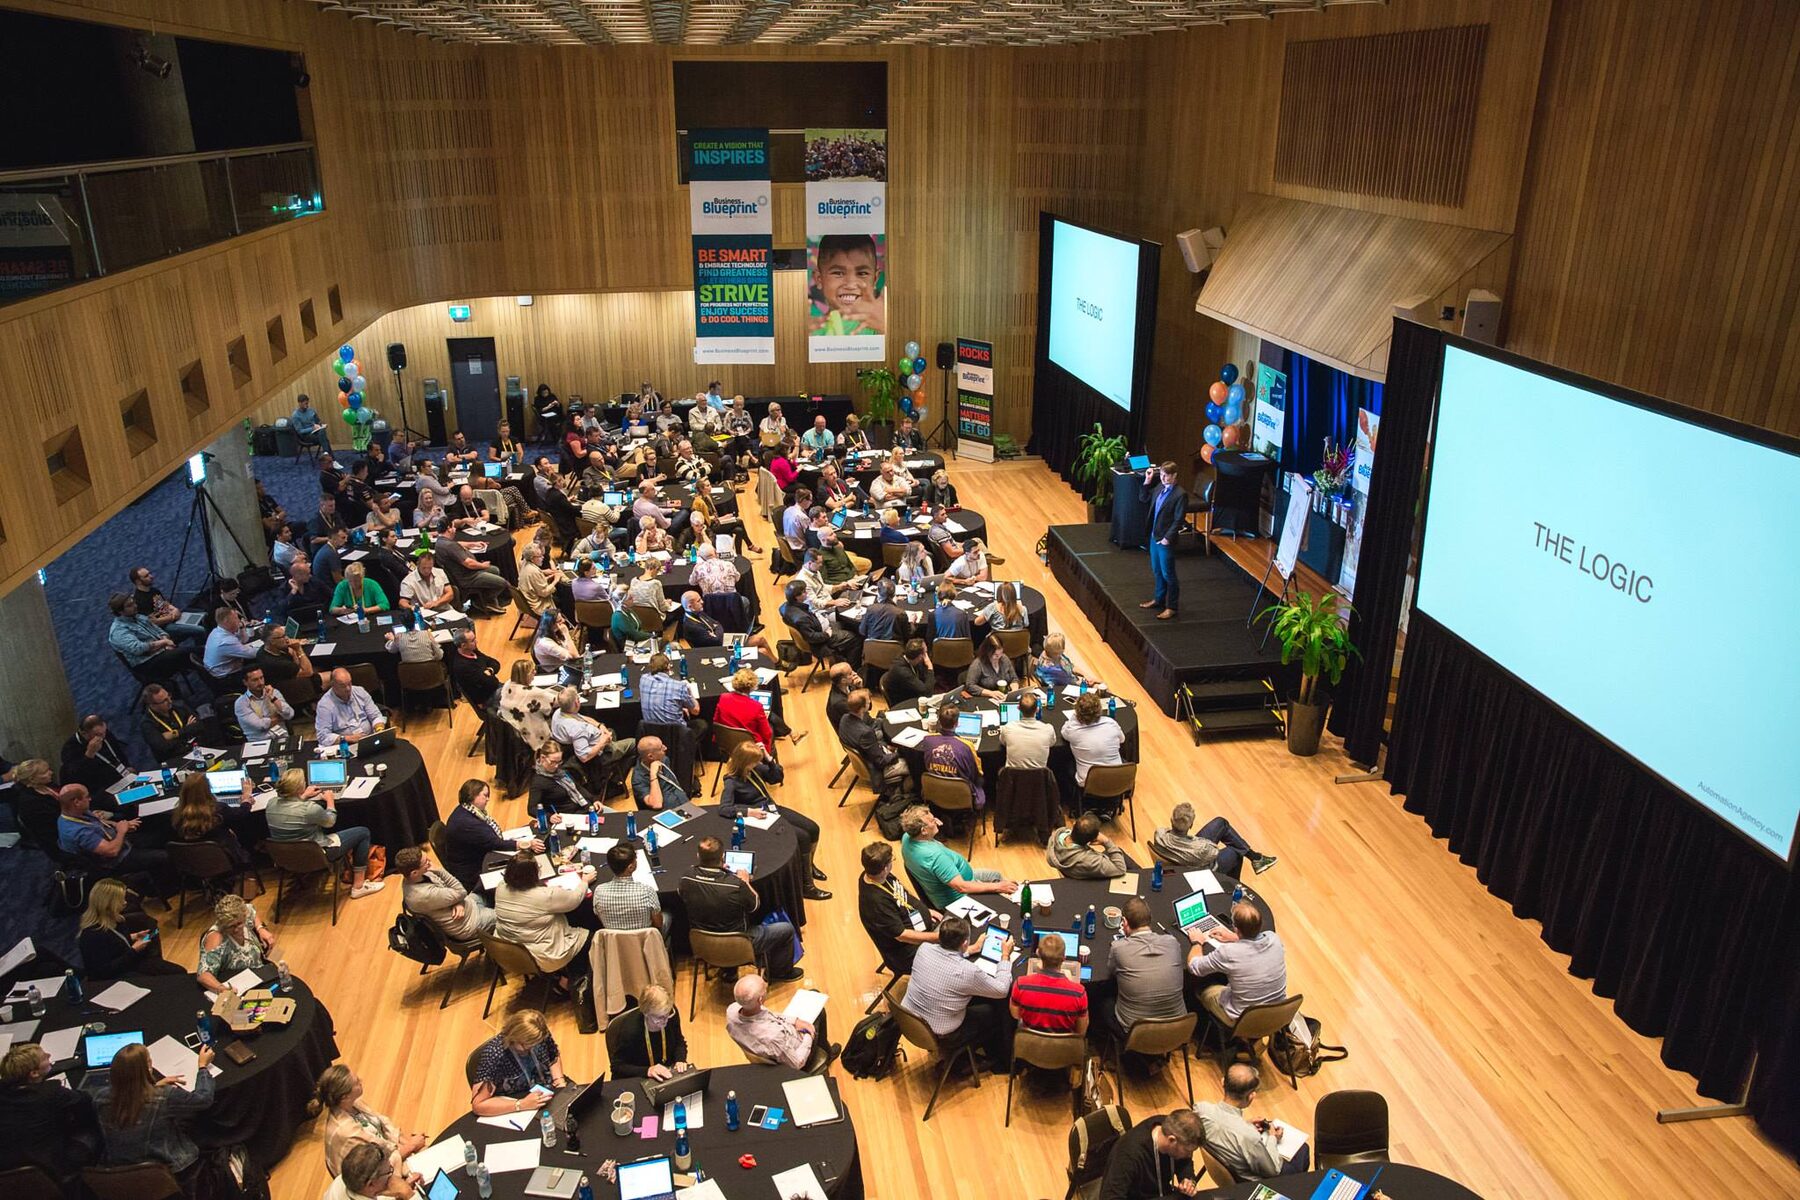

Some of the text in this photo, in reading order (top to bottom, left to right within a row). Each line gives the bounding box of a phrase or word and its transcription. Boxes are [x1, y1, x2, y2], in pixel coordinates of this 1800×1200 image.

[748, 141, 764, 149] THAT
[694, 149, 765, 165] INSPIRES
[713, 197, 741, 205] Business
[829, 197, 856, 205] Business
[703, 201, 758, 218] Blueprint
[817, 202, 872, 218] Blueprint
[698, 248, 768, 262] BE SMART
[699, 268, 768, 277] FIND GREATNESS
[700, 284, 769, 302] STRIVE
[701, 307, 769, 316] ENJOY SUCCESS
[1076, 297, 1103, 321] THE LOGIC
[960, 347, 990, 361] ROCKS
[969, 396, 990, 406] GREEN
[960, 409, 990, 422] MATTERS
[960, 421, 975, 433] LET
[977, 424, 990, 437] GO
[1534, 521, 1653, 603] THE LOGIC
[1697, 781, 1784, 842] AutomationAgency.com
